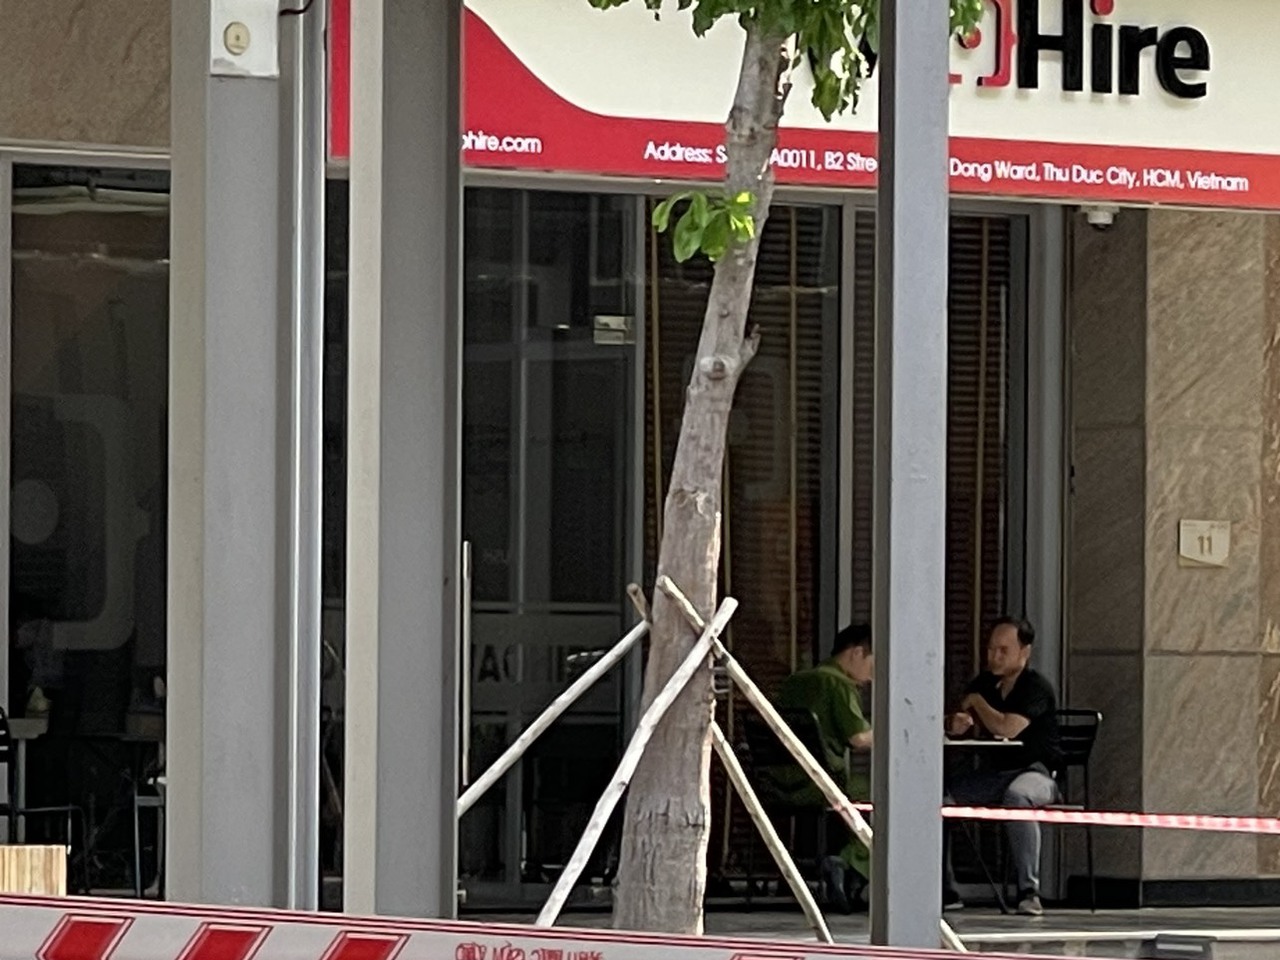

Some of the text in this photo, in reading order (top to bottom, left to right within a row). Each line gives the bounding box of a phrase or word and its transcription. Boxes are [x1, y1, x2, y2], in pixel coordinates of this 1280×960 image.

[462, 130, 543, 154] hire.com
[643, 141, 713, 163] Address:
[769, 149, 878, 172] A0011, B2 Stre
[949, 157, 1249, 191] Dong Ward, Thu Duc City, HCM, Vietnam
